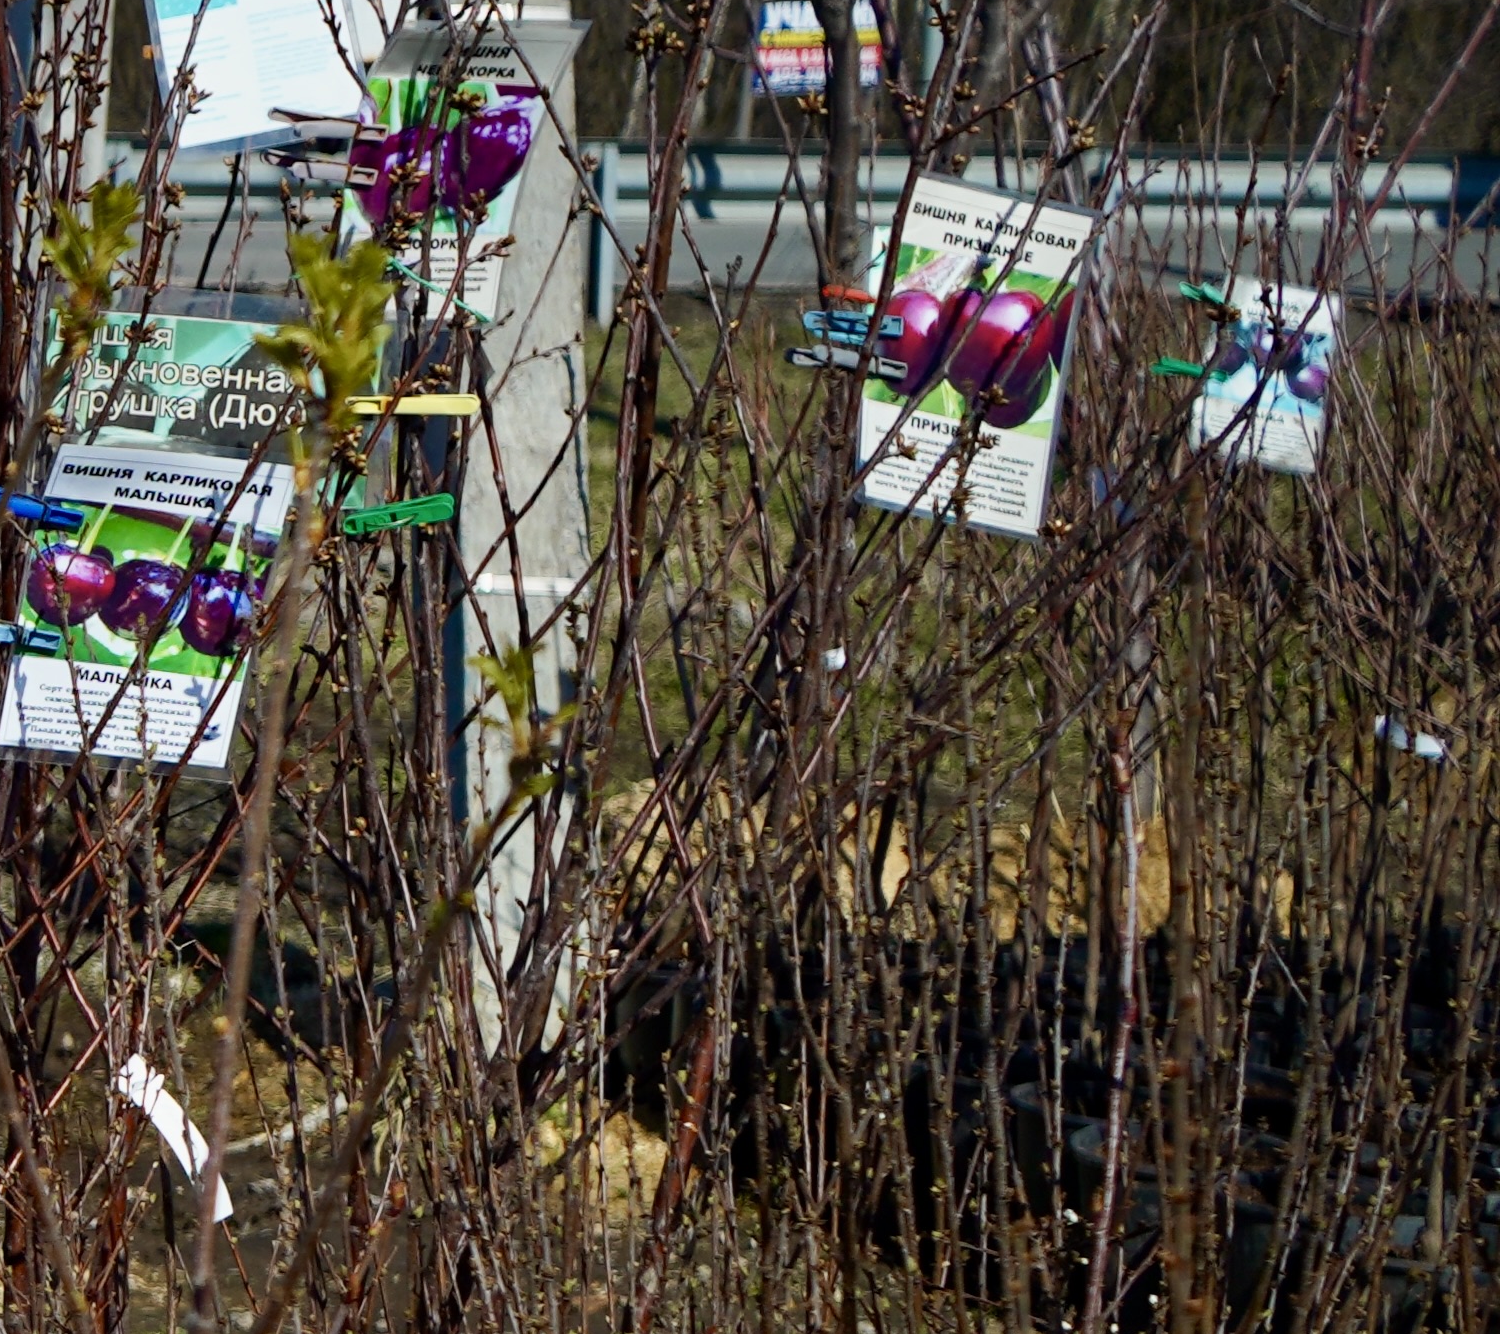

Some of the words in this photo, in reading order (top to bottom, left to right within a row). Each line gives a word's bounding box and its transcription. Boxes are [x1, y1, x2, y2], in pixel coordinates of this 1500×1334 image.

[912, 201, 967, 225] ВИШНЯ
[944, 232, 1034, 263] ПРИЗВАНЕ
[62, 464, 134, 480] ВИШНЯ
[145, 470, 273, 497] КАРЛИКОАЯ
[114, 486, 216, 510] МАЛЫШКА
